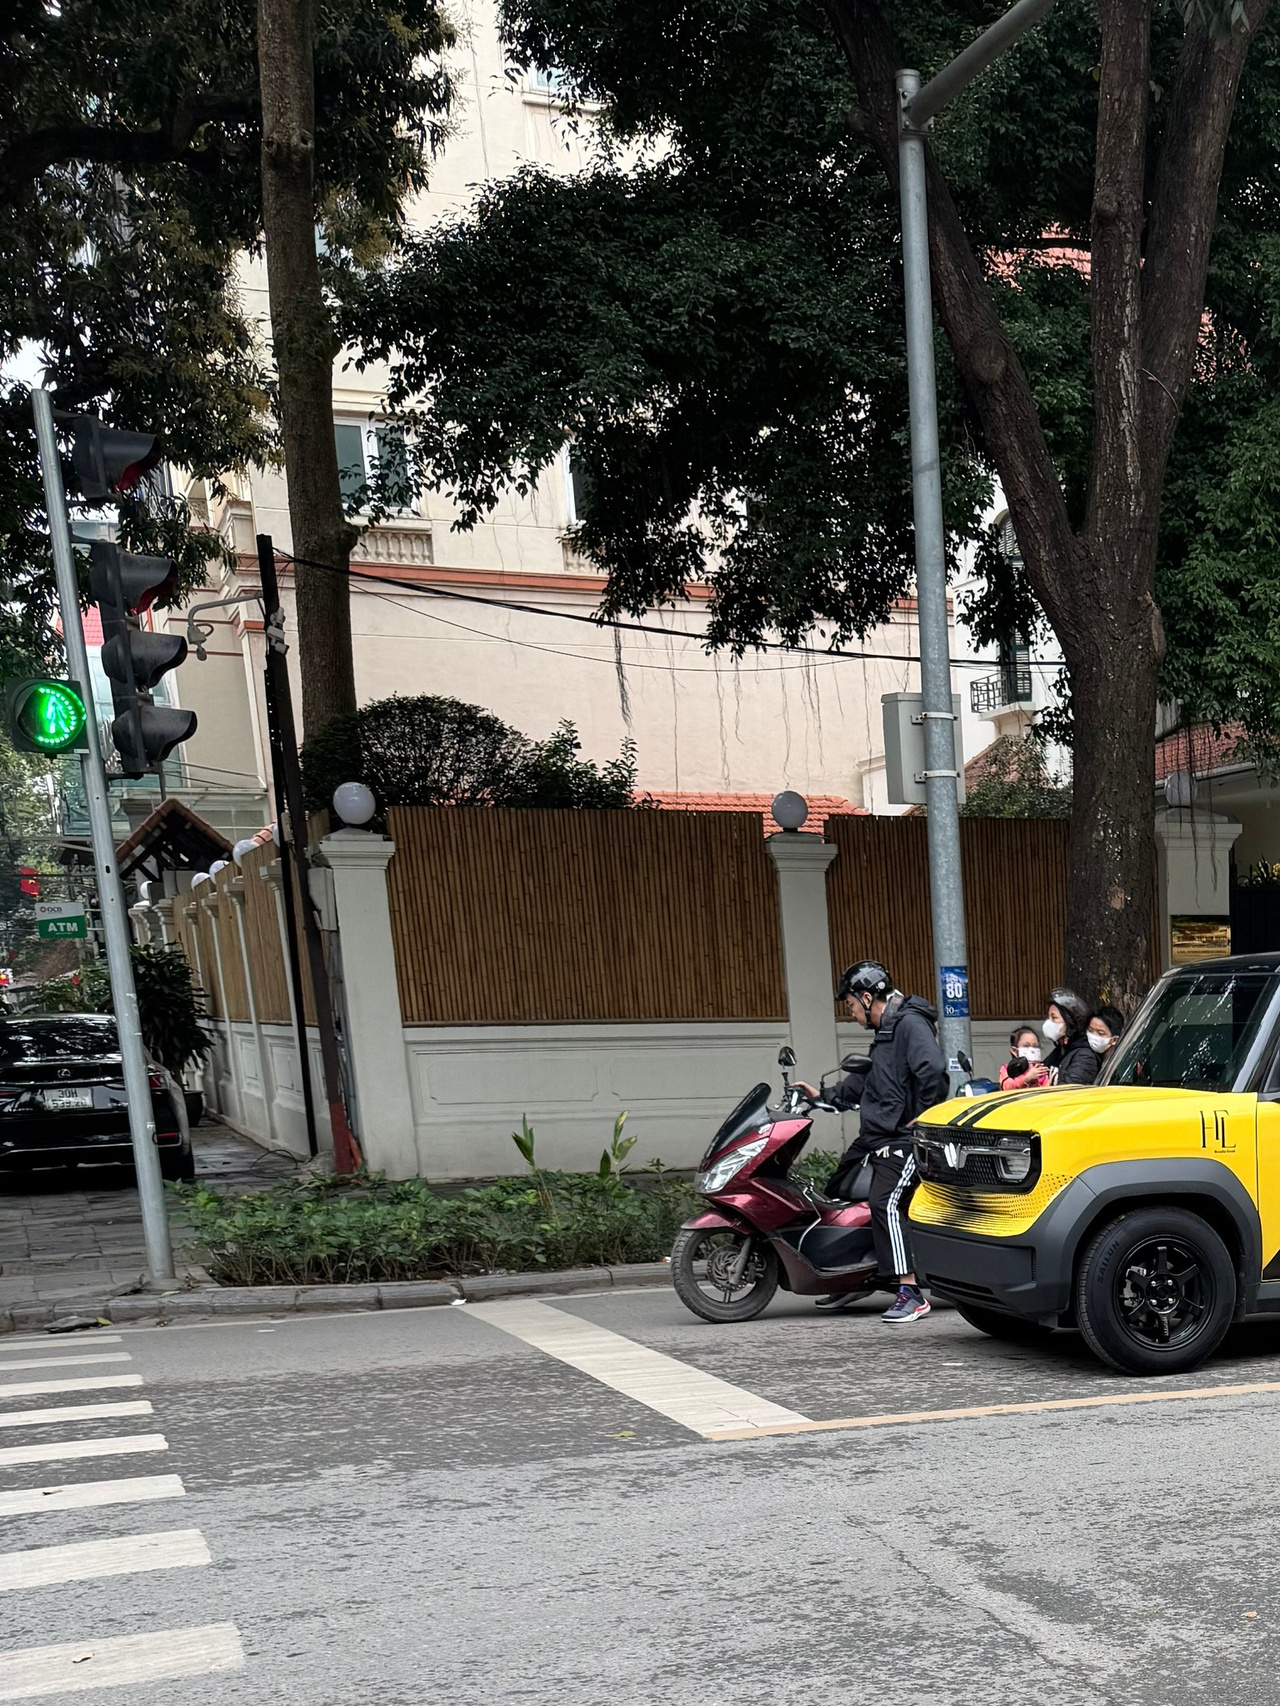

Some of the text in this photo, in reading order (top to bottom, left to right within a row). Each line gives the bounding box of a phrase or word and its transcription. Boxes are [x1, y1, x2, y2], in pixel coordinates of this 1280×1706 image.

[48, 922, 78, 932] ATM
[946, 983, 963, 999] 80
[58, 1089, 78, 1099] 30H
